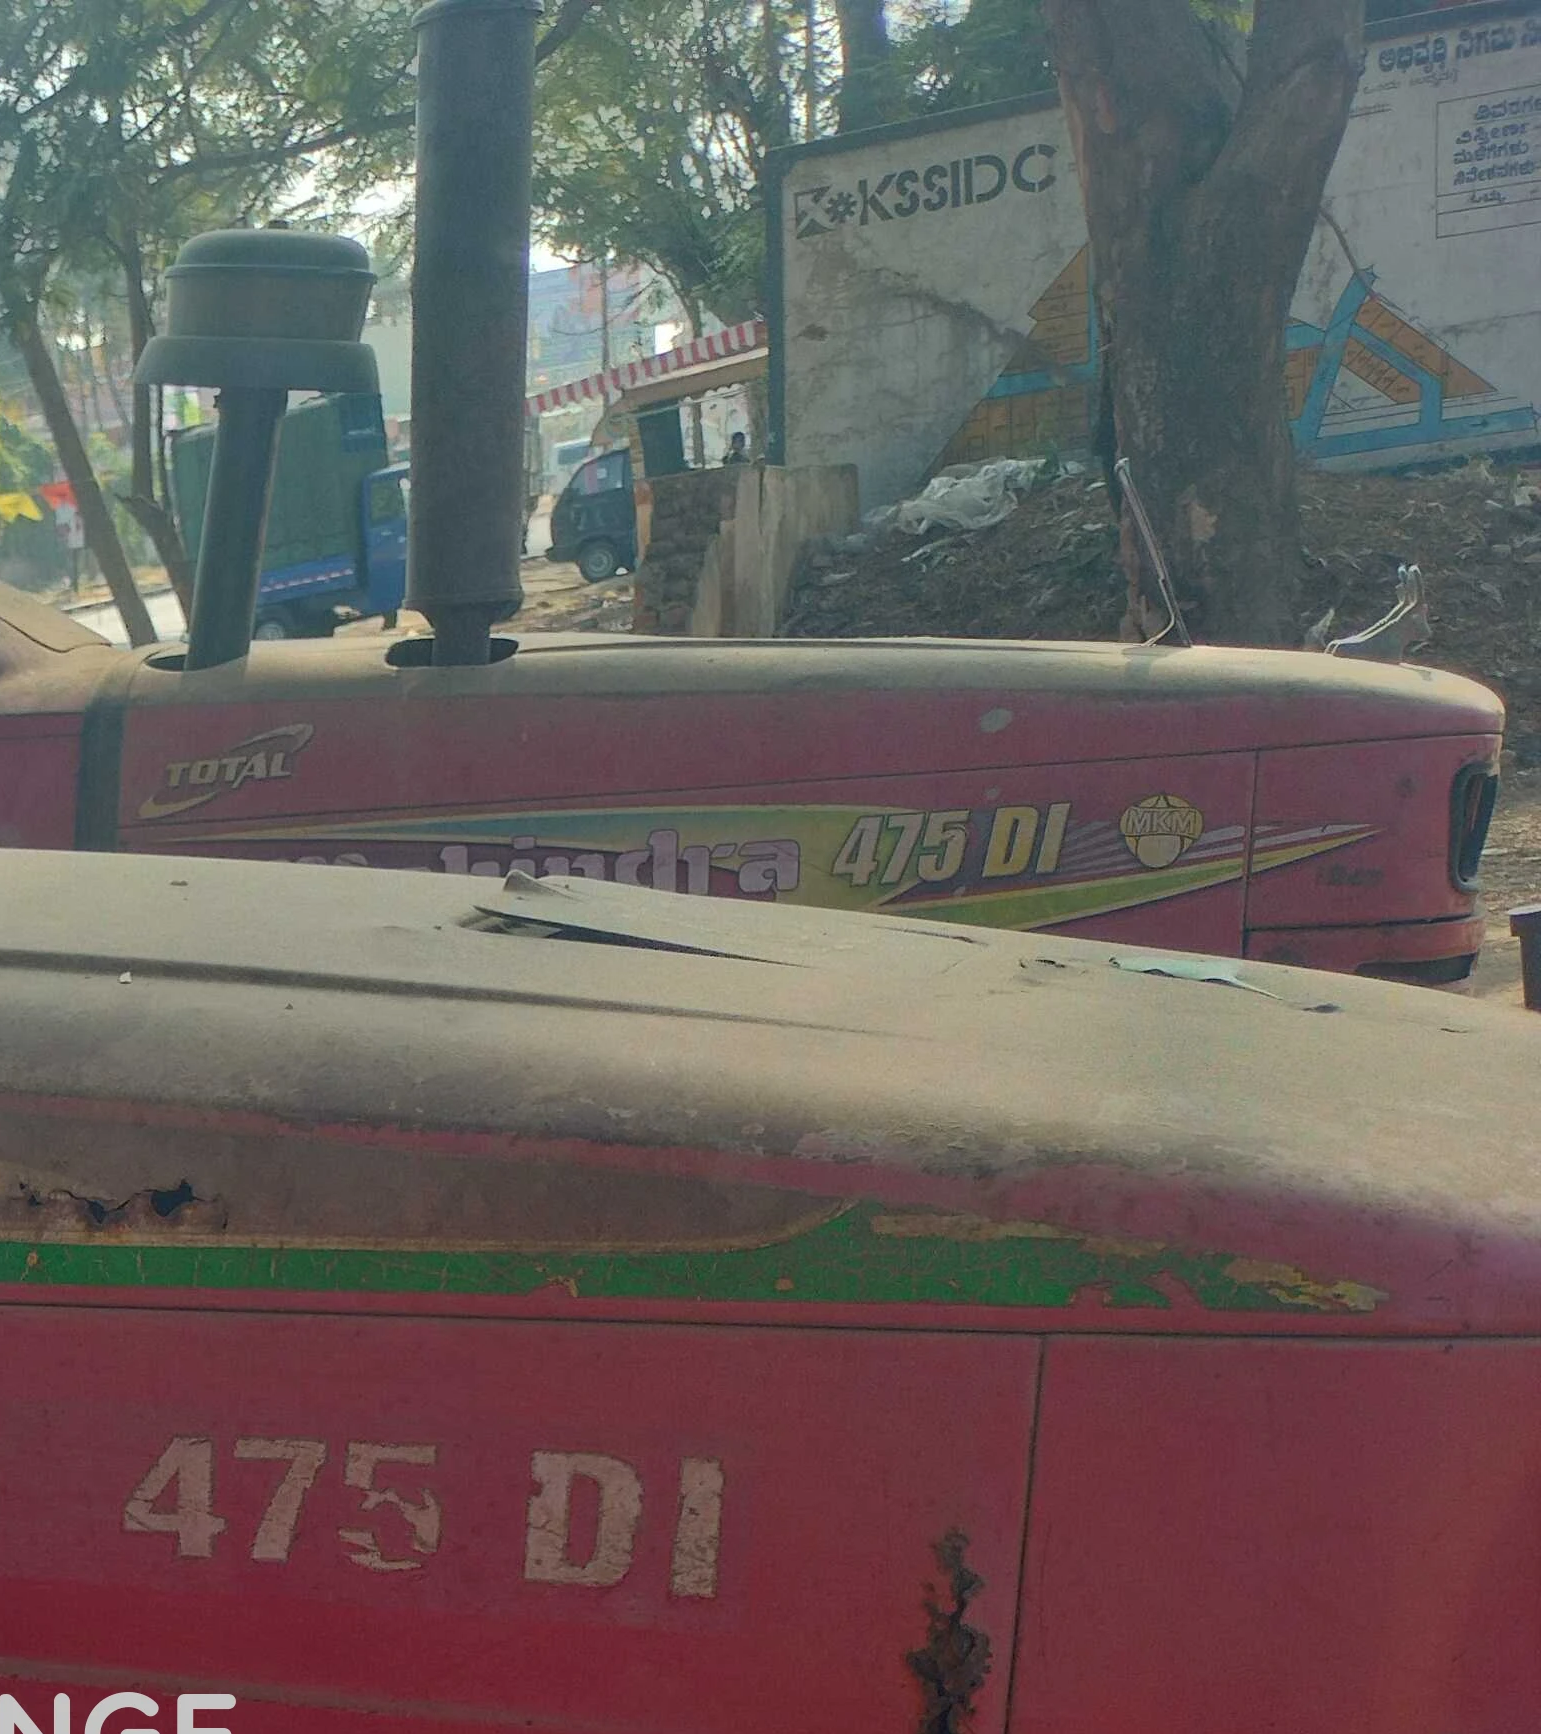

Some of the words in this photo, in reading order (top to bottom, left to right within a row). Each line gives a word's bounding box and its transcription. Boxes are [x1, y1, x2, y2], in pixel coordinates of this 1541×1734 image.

[858, 143, 1058, 226] KSSIDC
[165, 751, 293, 789] TOTAL
[831, 808, 971, 888] 475
[981, 802, 1073, 880] DI
[1125, 806, 1201, 836] MKM
[123, 1435, 444, 1573] 475
[521, 1448, 726, 1601] DI
